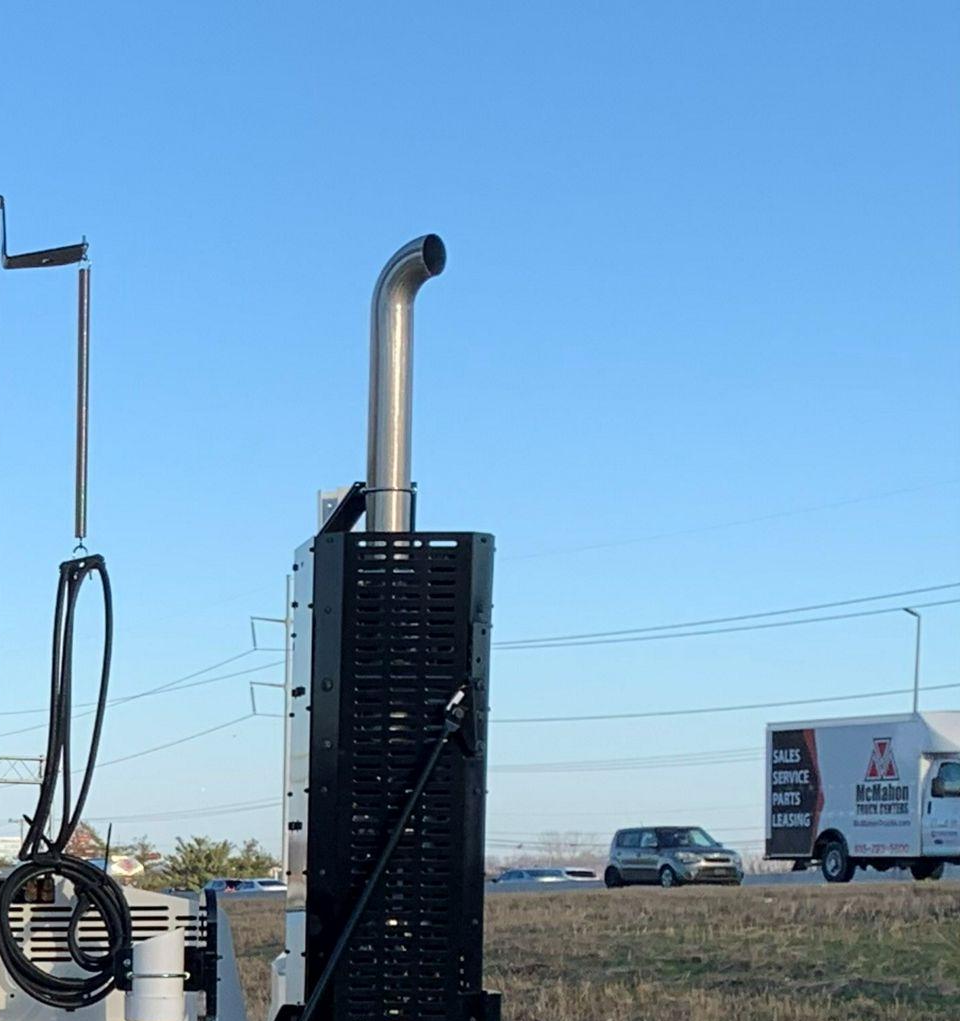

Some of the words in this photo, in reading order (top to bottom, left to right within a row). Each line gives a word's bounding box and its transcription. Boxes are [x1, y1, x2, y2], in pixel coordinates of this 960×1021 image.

[773, 748, 801, 764] SALES
[773, 769, 810, 785] SERVICE
[773, 791, 801, 806] PARTS
[856, 783, 909, 802] McMahon
[856, 803, 878, 815] TRUCK
[772, 812, 811, 828] LEASING
